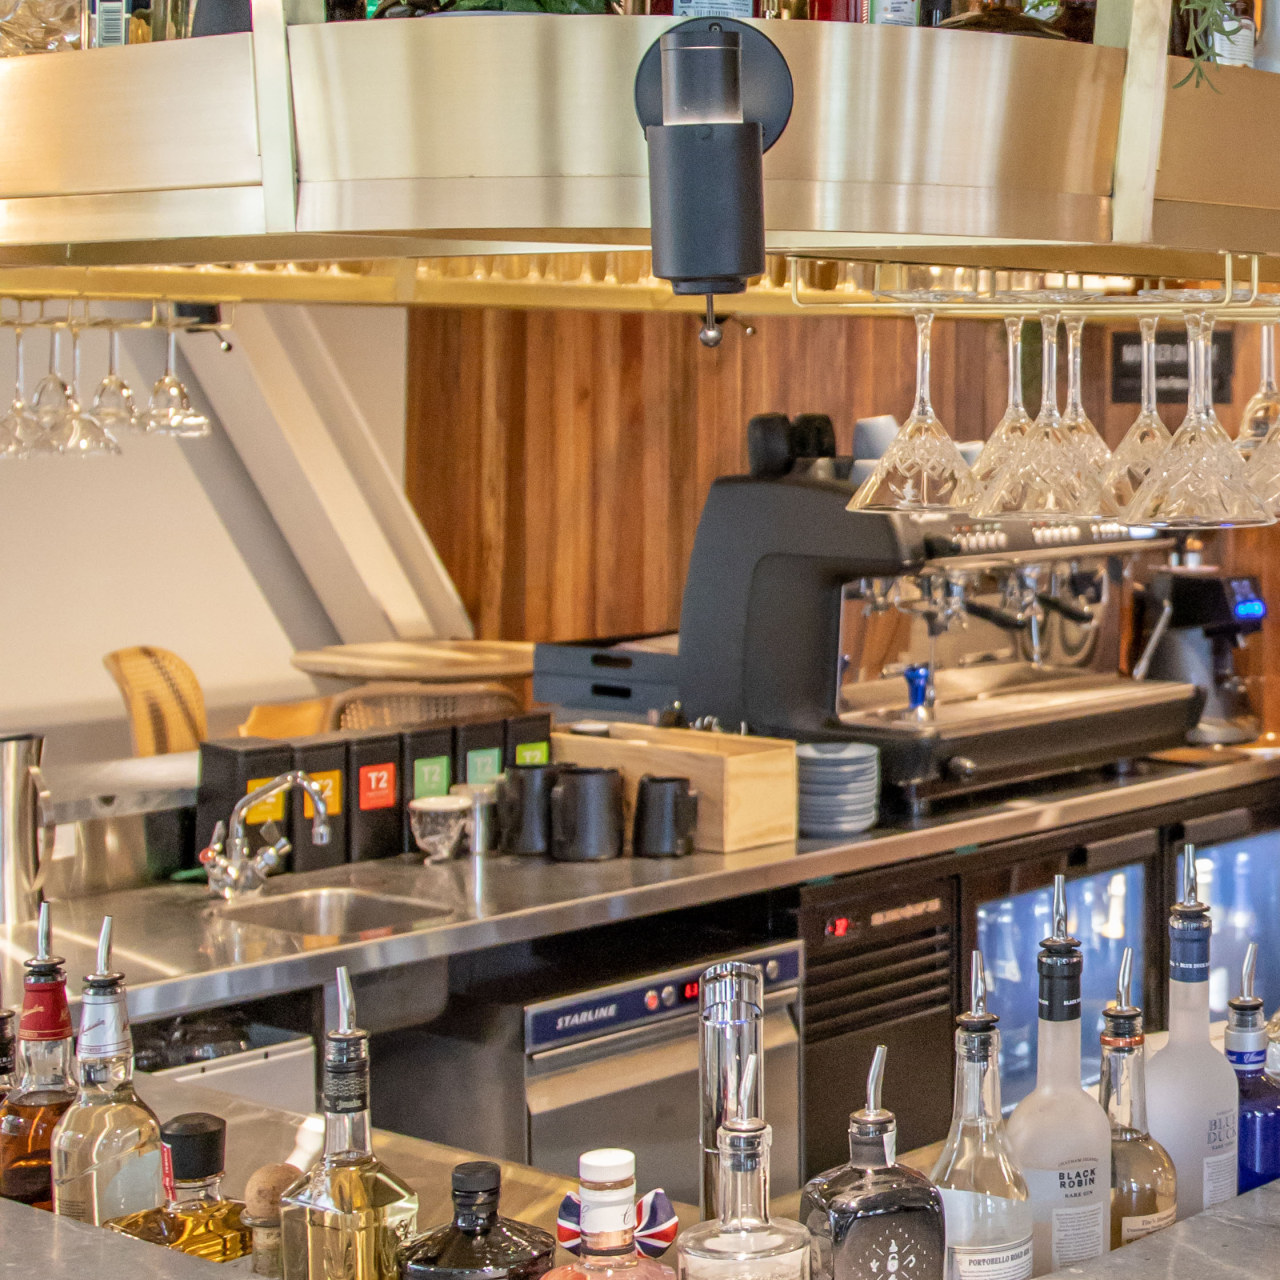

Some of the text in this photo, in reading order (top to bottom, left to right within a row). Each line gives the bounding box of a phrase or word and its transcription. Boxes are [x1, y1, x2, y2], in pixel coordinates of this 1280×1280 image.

[367, 770, 388, 790] T2
[422, 765, 441, 783] T2
[556, 1004, 617, 1030] STARLINE
[1059, 1167, 1097, 1181] BLACK
[1059, 1177, 1095, 1189] ROBIN
[1065, 1191, 1082, 1199] RARE
[968, 1255, 1010, 1267] PORTOBELLO
[1010, 1251, 1023, 1262] ROAD
